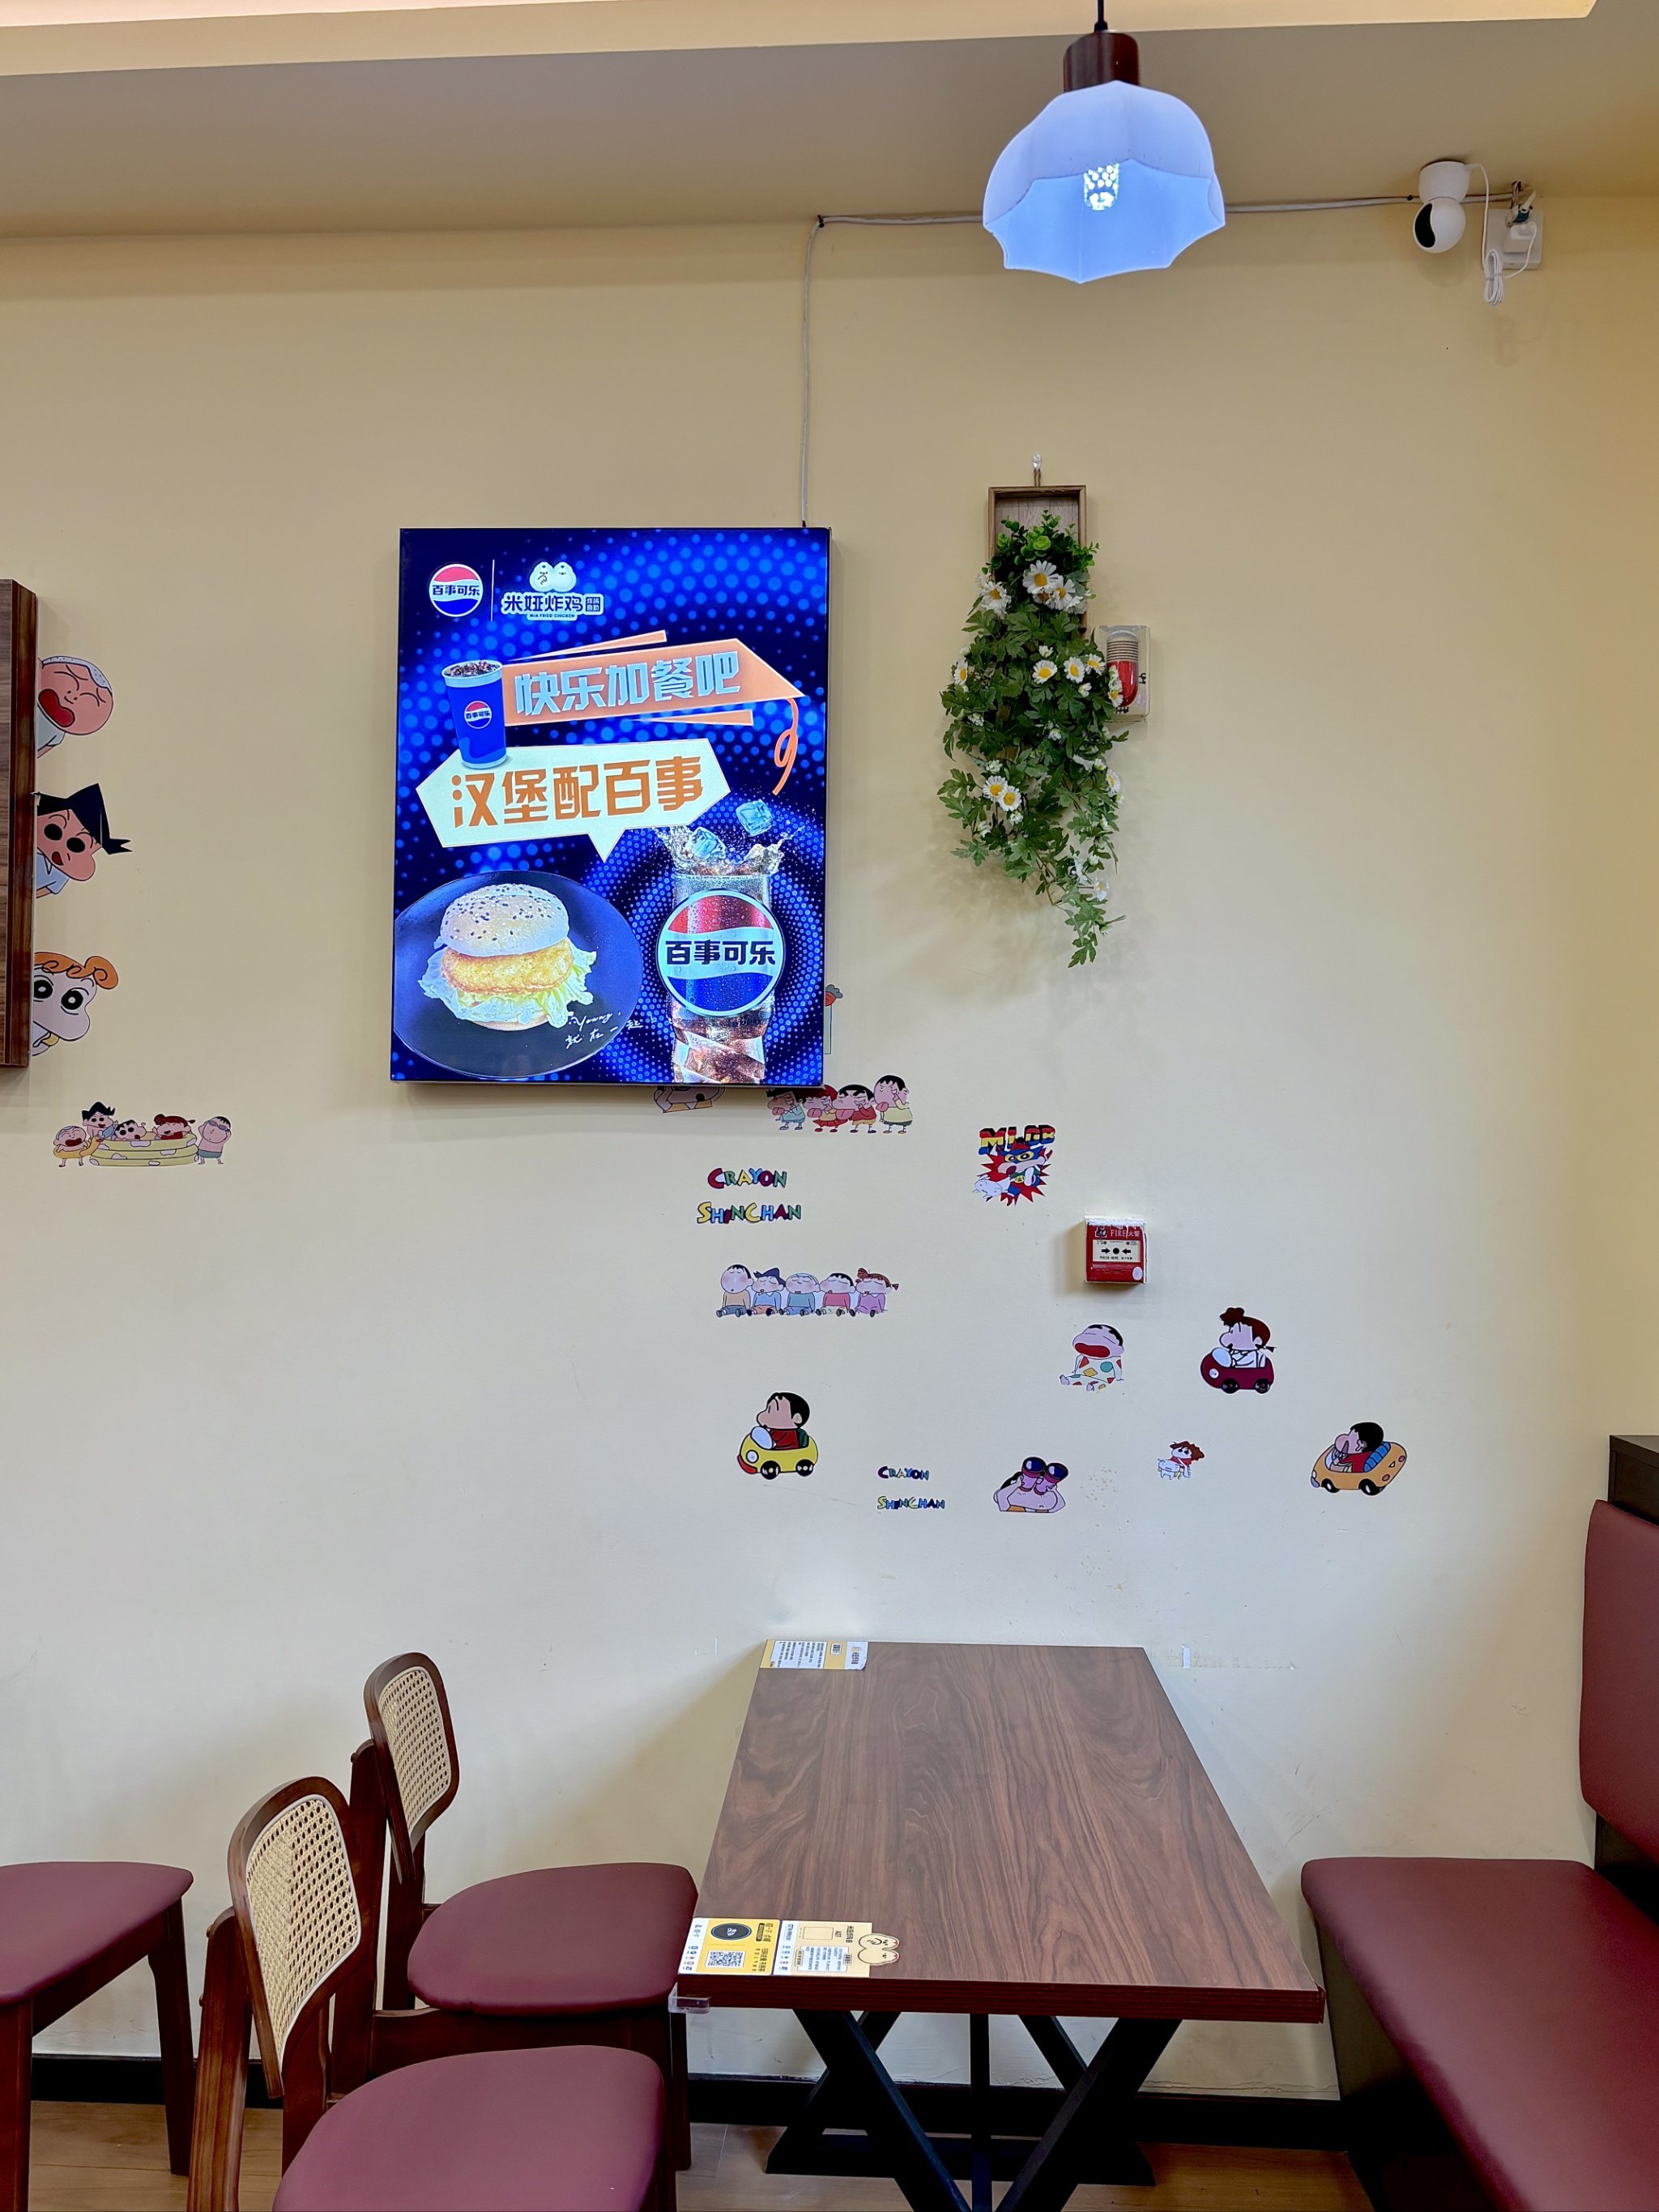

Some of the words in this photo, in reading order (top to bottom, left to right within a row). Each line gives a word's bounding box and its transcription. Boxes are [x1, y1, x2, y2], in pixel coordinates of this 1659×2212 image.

[433, 585, 480, 595] 百事可乐
[514, 651, 740, 716] 快乐加餐吧
[450, 756, 703, 829] 汉堡配百事
[665, 940, 776, 965] 百事可乐
[707, 1167, 787, 1189] CRAYON
[697, 1201, 802, 1224] SHINCHAN
[877, 1465, 929, 1481] CRAYON
[876, 1495, 945, 1510] SHINCHAN
